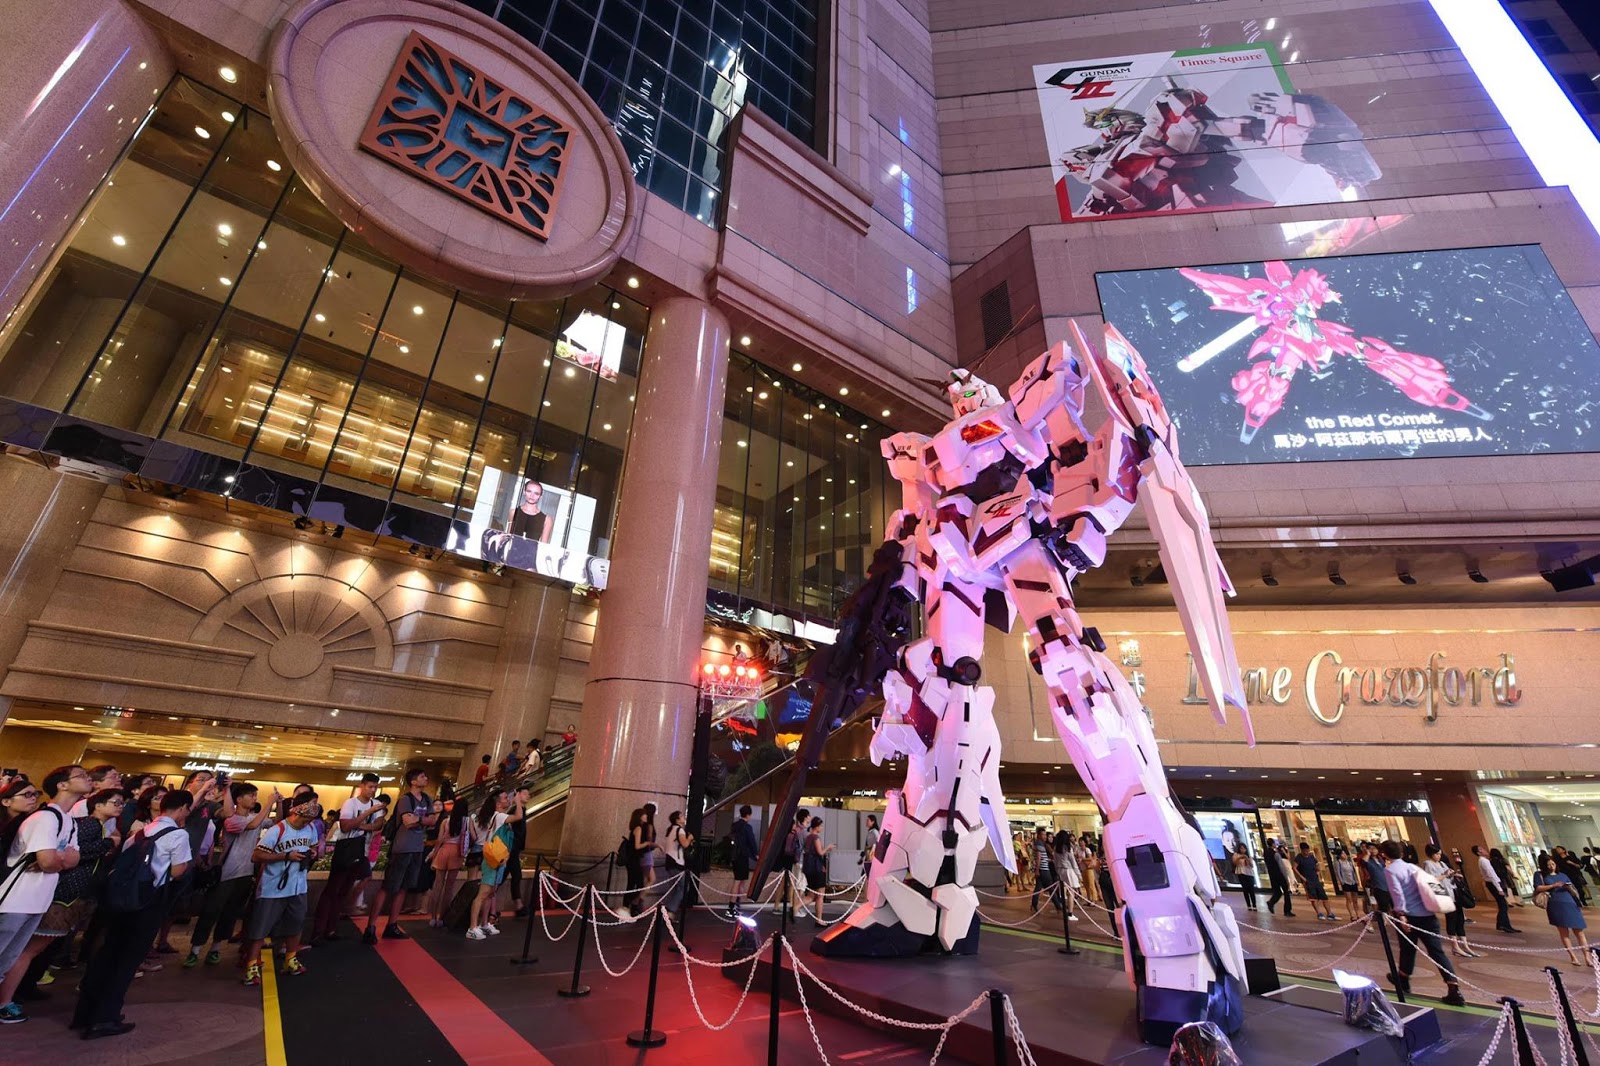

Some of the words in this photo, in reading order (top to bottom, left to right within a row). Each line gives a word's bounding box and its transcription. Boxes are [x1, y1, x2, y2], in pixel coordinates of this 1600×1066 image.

[1178, 59, 1216, 67] Times
[1219, 53, 1262, 63] Square
[1080, 67, 1131, 77] GUNDAM
[1305, 416, 1336, 429] the
[1337, 414, 1375, 428] Red
[1378, 412, 1443, 426] Comet.
[1181, 652, 1292, 705] Lne
[1305, 650, 1522, 726] Crawford
